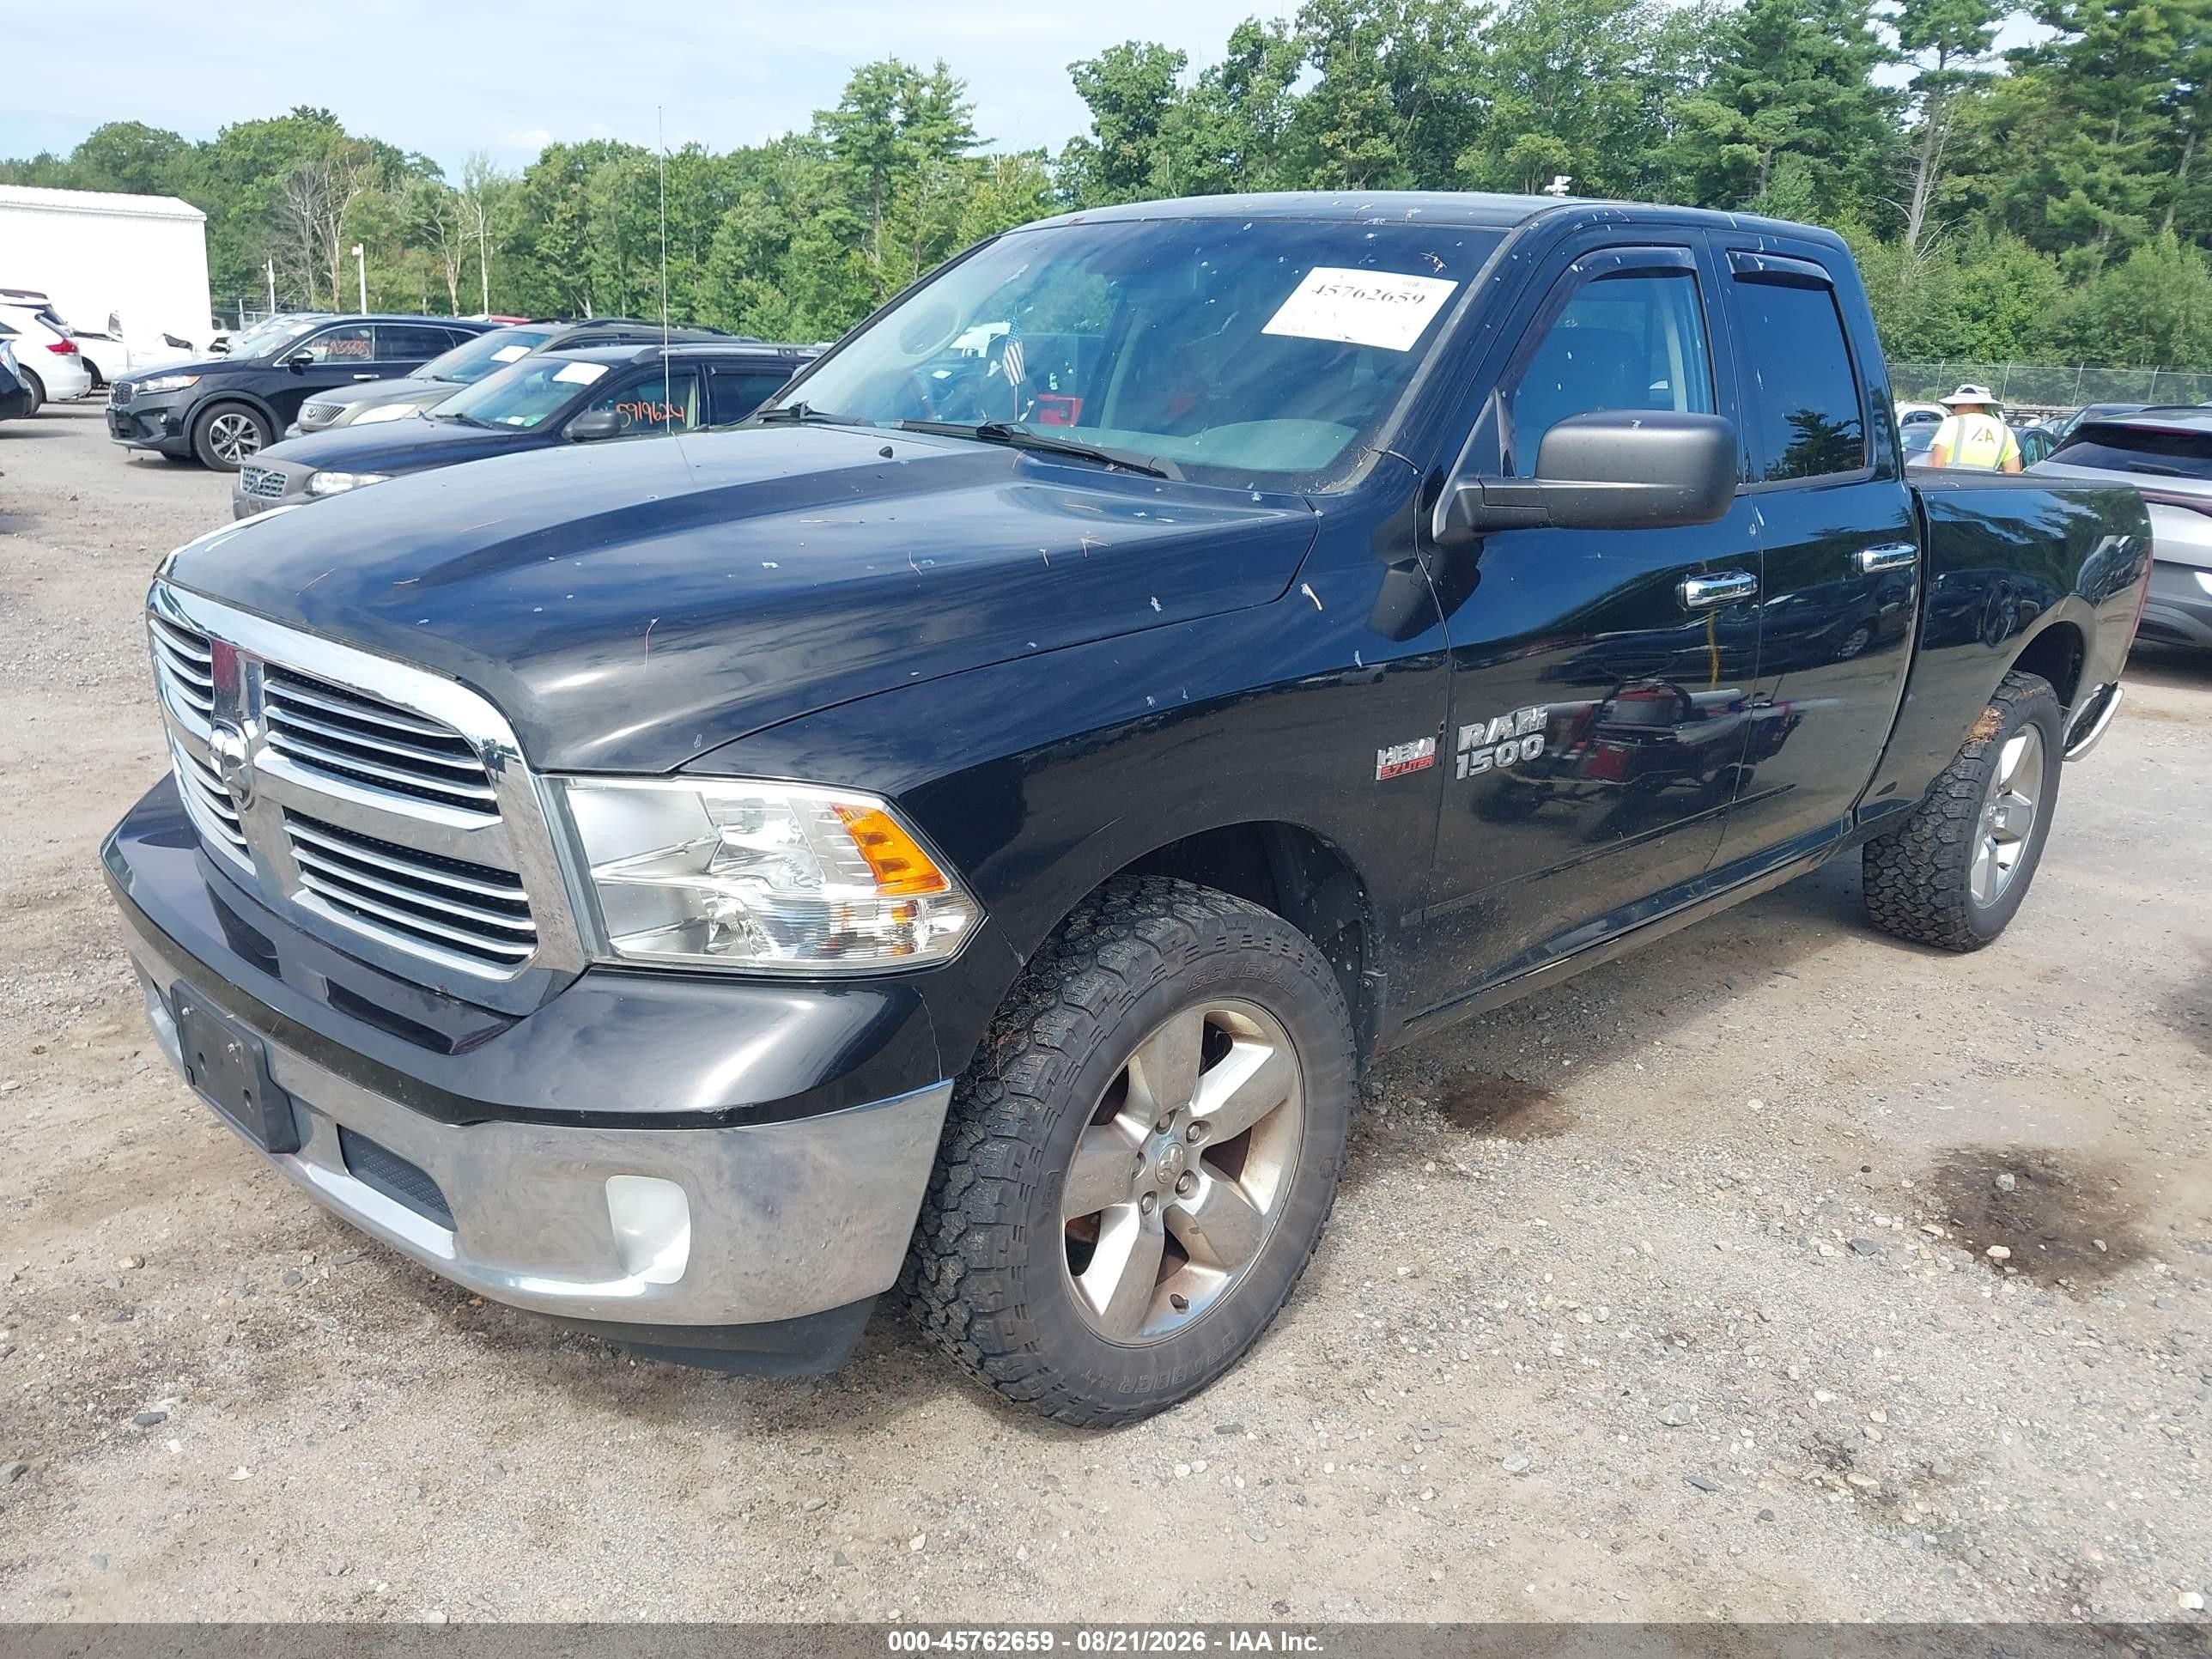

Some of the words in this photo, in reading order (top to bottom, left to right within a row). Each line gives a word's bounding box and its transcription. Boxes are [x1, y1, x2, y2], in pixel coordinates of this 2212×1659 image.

[1310, 283, 1426, 305] 45762659
[1457, 706, 1548, 752] RAM
[1455, 733, 1545, 781] 1500
[1188, 961, 1299, 999] GENERAL
